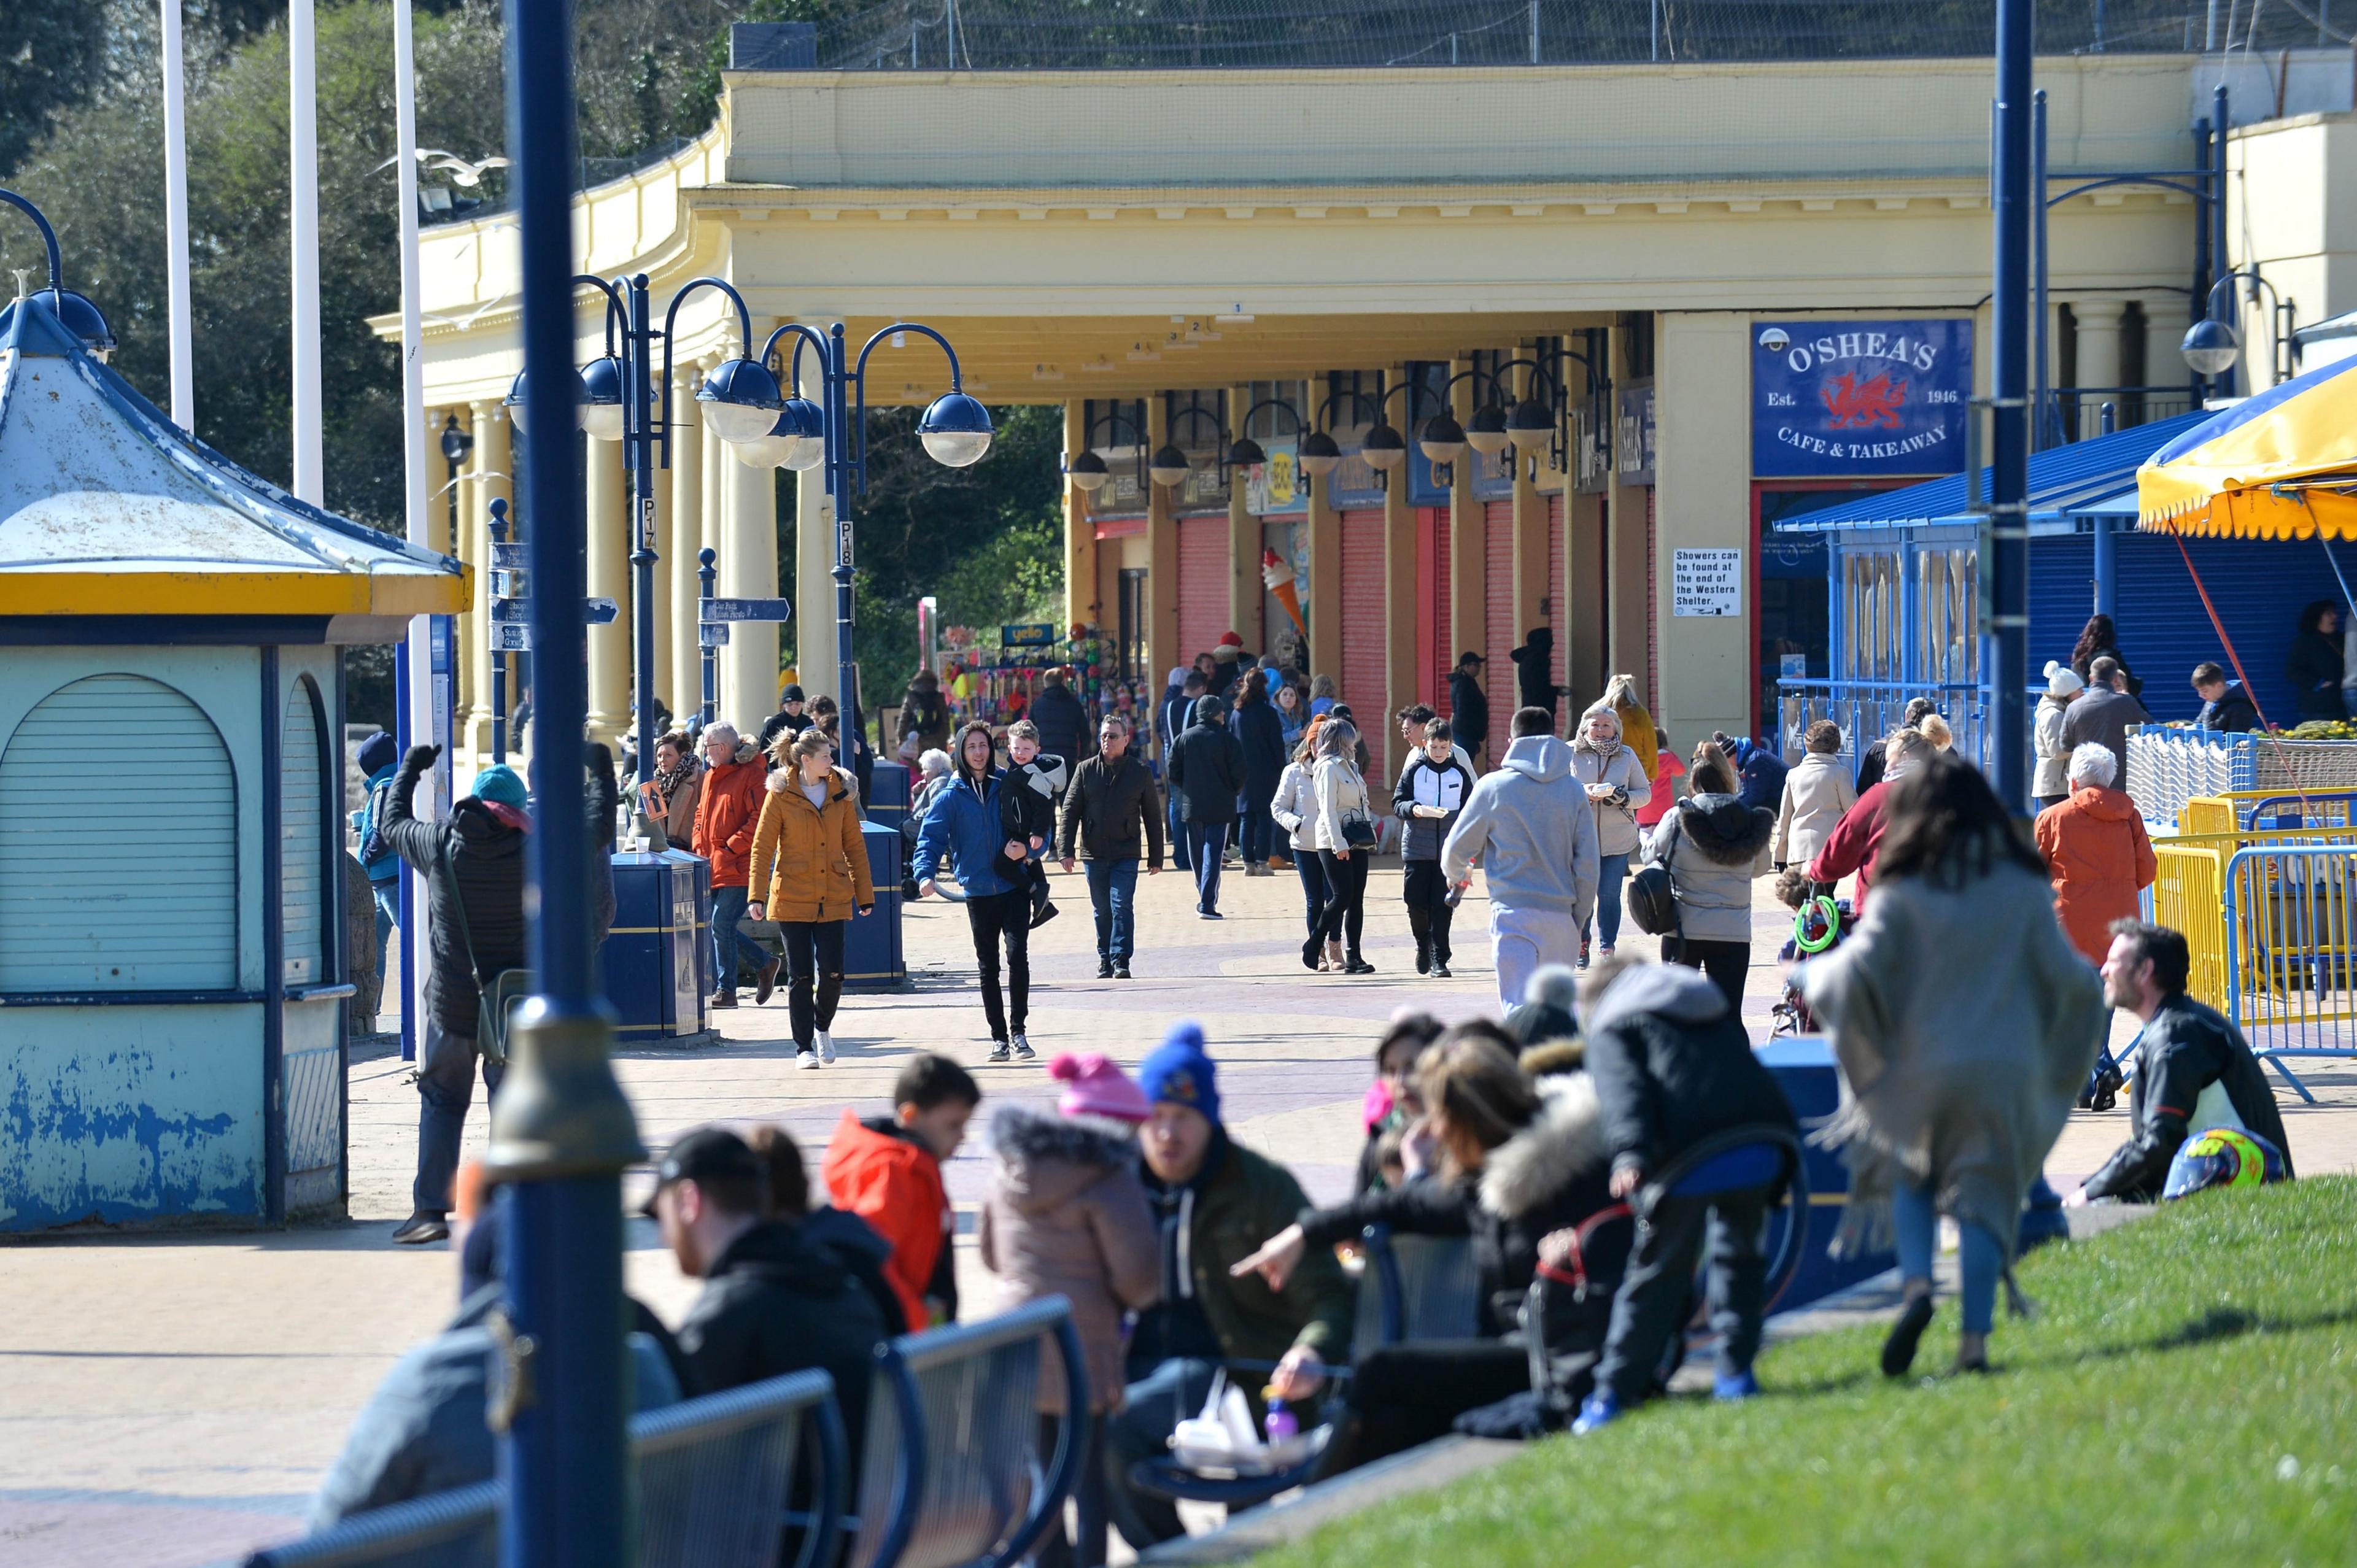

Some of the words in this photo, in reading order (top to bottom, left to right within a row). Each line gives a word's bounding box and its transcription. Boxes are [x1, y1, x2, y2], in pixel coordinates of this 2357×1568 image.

[1235, 303, 1241, 312] 1
[1193, 322, 1199, 331] 2
[1171, 332, 1177, 341] 3
[1134, 342, 1140, 351] 4
[1788, 332, 1937, 373] O'SHEA'S
[1767, 392, 1796, 406] Est.
[1927, 391, 1957, 403] 1946
[1778, 427, 1827, 454] CAFE
[1829, 442, 1844, 457] &
[1848, 425, 1948, 458] TAKEAWAY
[644, 500, 655, 547] P17
[842, 523, 851, 565] P18
[1676, 551, 1717, 560] Showers
[1676, 562, 1687, 571] be
[1692, 562, 1718, 571] found
[1722, 562, 1732, 571] at
[1677, 574, 1692, 582] the
[1696, 574, 1713, 582] end
[1716, 574, 1726, 582] of
[1677, 585, 1692, 594] the
[1696, 585, 1735, 593] Western
[1676, 597, 1714, 605] Shelter.
